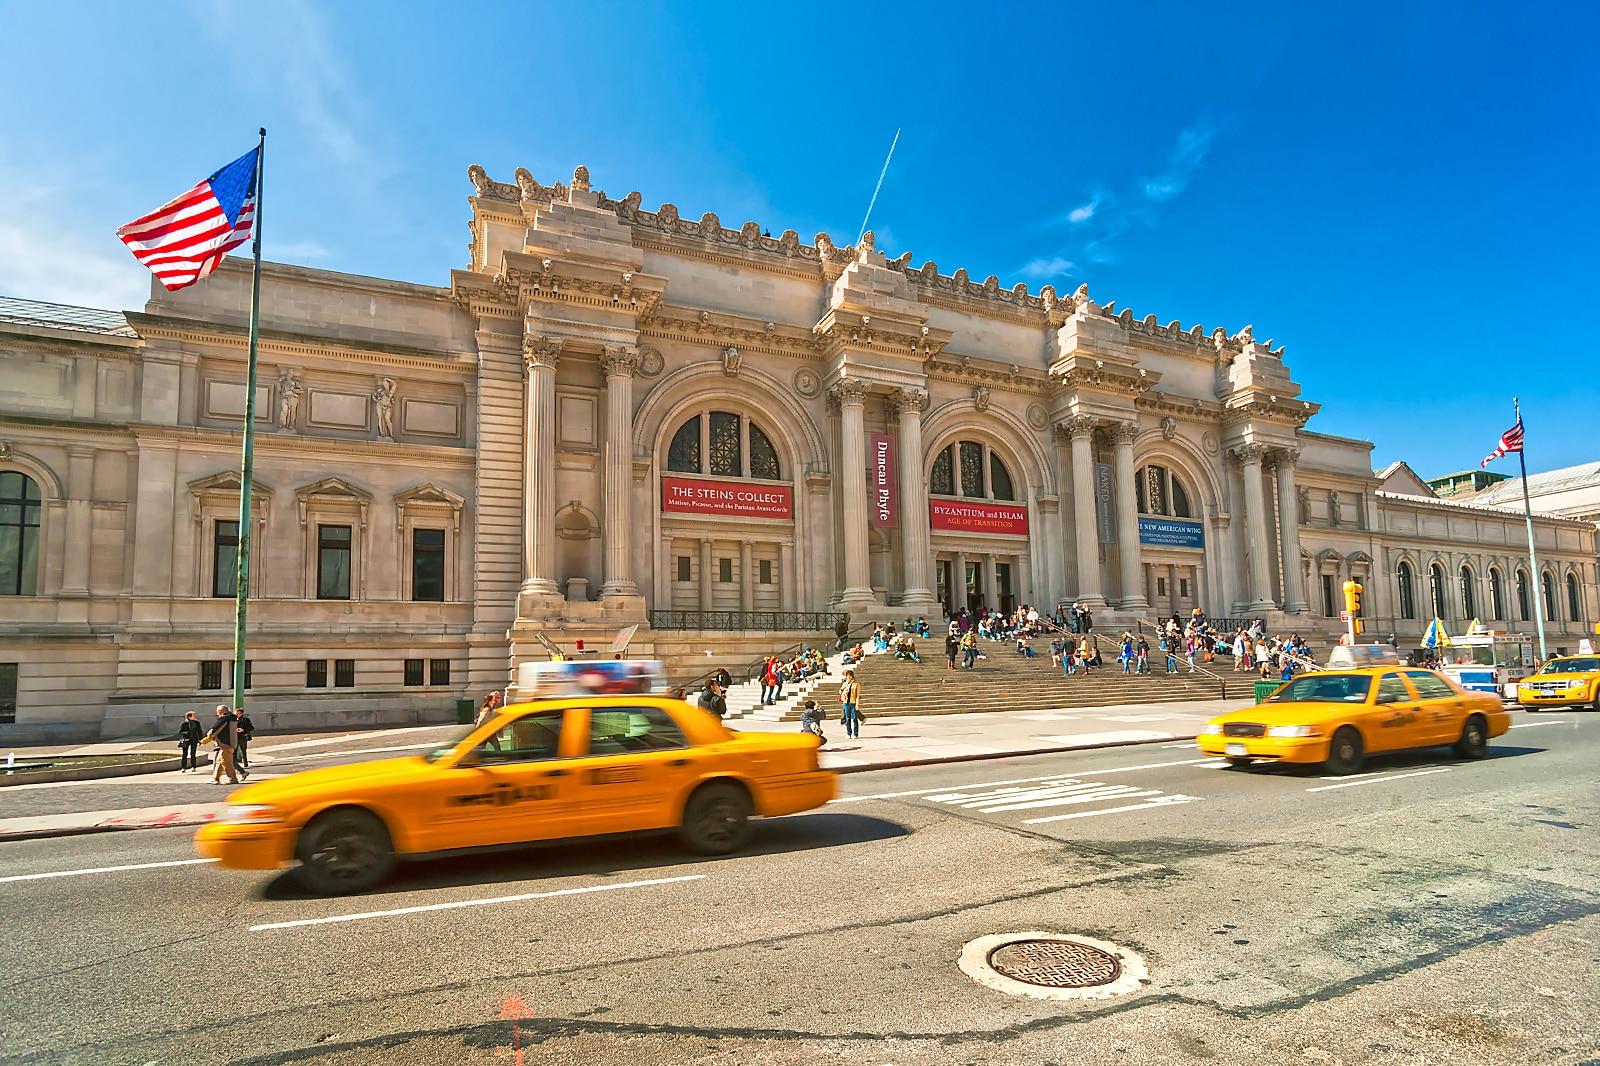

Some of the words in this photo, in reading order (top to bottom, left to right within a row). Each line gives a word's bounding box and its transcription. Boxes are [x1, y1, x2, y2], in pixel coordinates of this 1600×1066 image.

[877, 441, 888, 485] Duncan
[1100, 465, 1110, 503] NAKED
[671, 486, 693, 497] THE
[697, 488, 734, 500] STEINS
[737, 492, 784, 504] COLLECT
[734, 503, 755, 511] Parisian
[876, 488, 890, 521] Phyfe
[934, 506, 985, 518] BYZANTIUM
[986, 511, 998, 519] and
[999, 511, 1024, 520] ISLAM
[947, 517, 961, 525] AGE
[974, 519, 1013, 528] TRANSITION
[1158, 524, 1186, 533] AMERICAN
